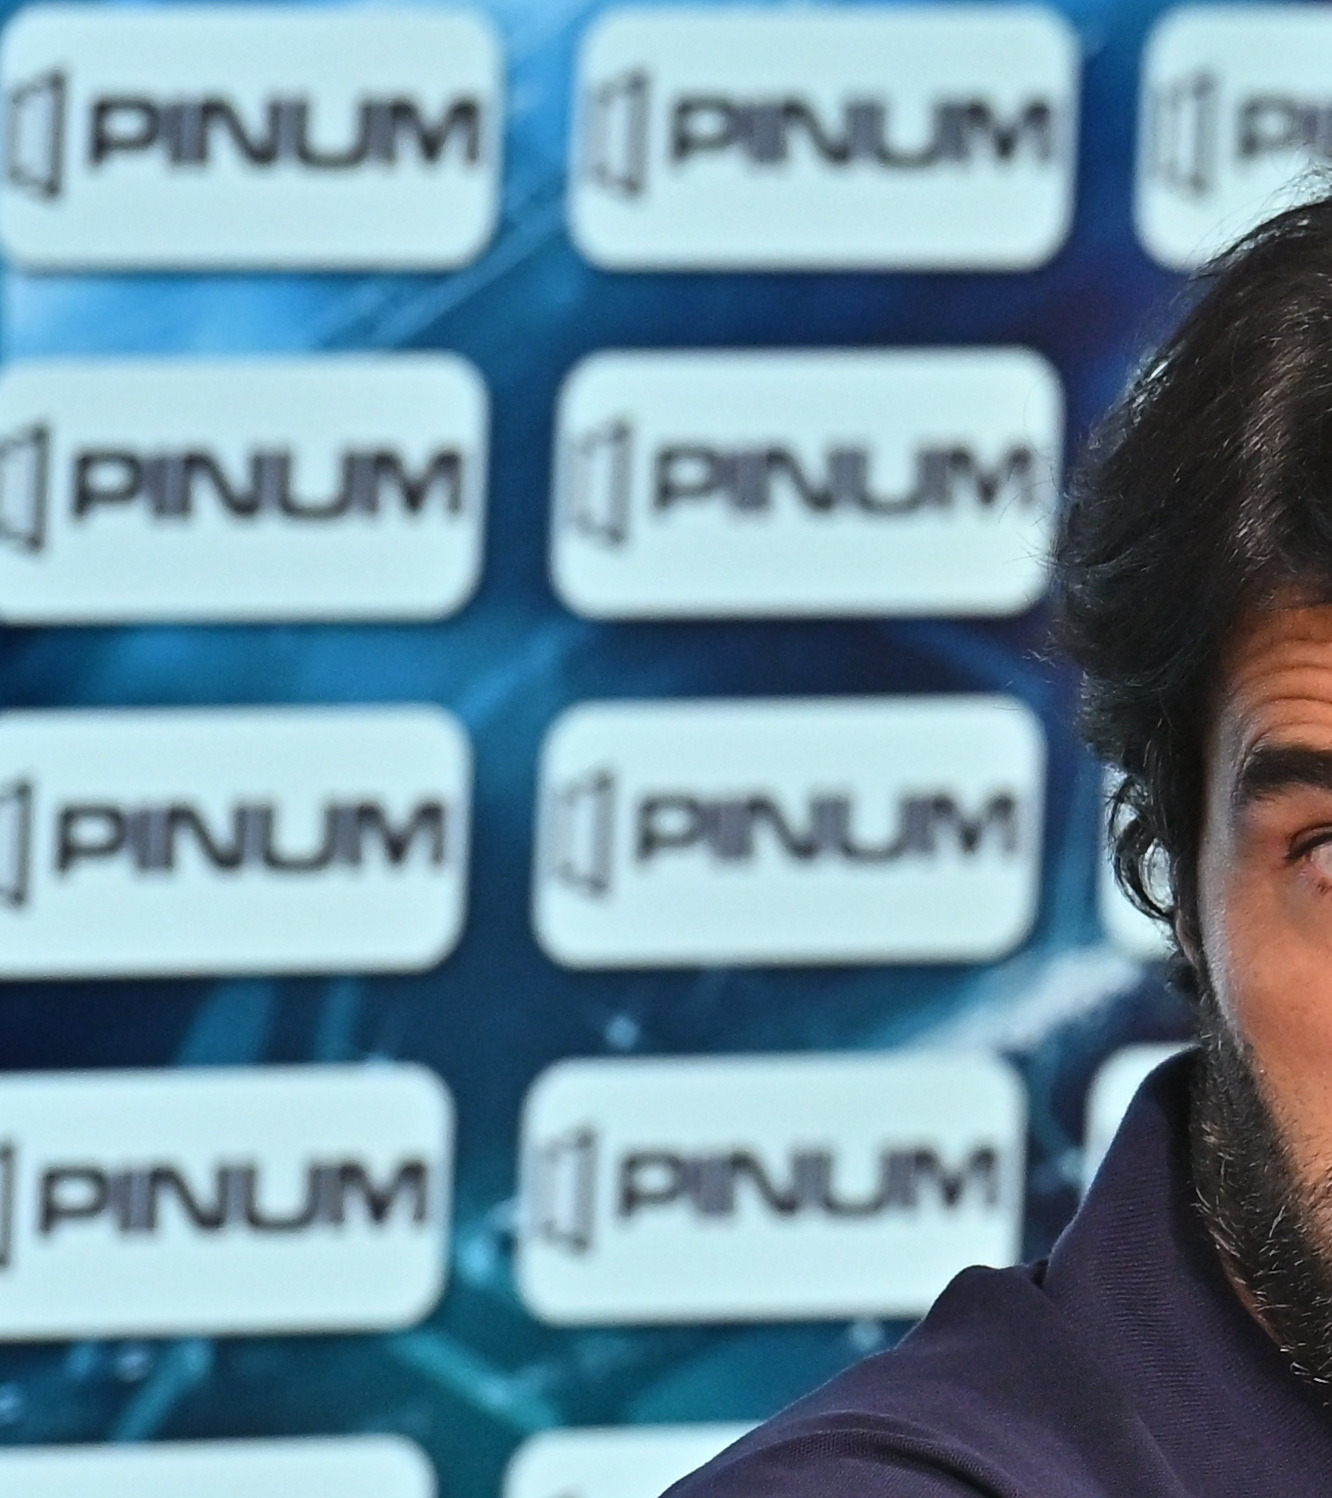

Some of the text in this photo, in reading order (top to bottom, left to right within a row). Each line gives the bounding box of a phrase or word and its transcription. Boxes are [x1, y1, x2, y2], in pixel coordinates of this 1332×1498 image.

[87, 95, 485, 171] PINUM
[669, 95, 1058, 171] PINUM
[70, 447, 466, 523] PINUM
[651, 443, 1035, 518] PINUM
[53, 799, 449, 875] PINUM
[634, 790, 1021, 866] PINUM
[36, 1157, 432, 1237] PINUM
[616, 1144, 1003, 1220] PINUM
